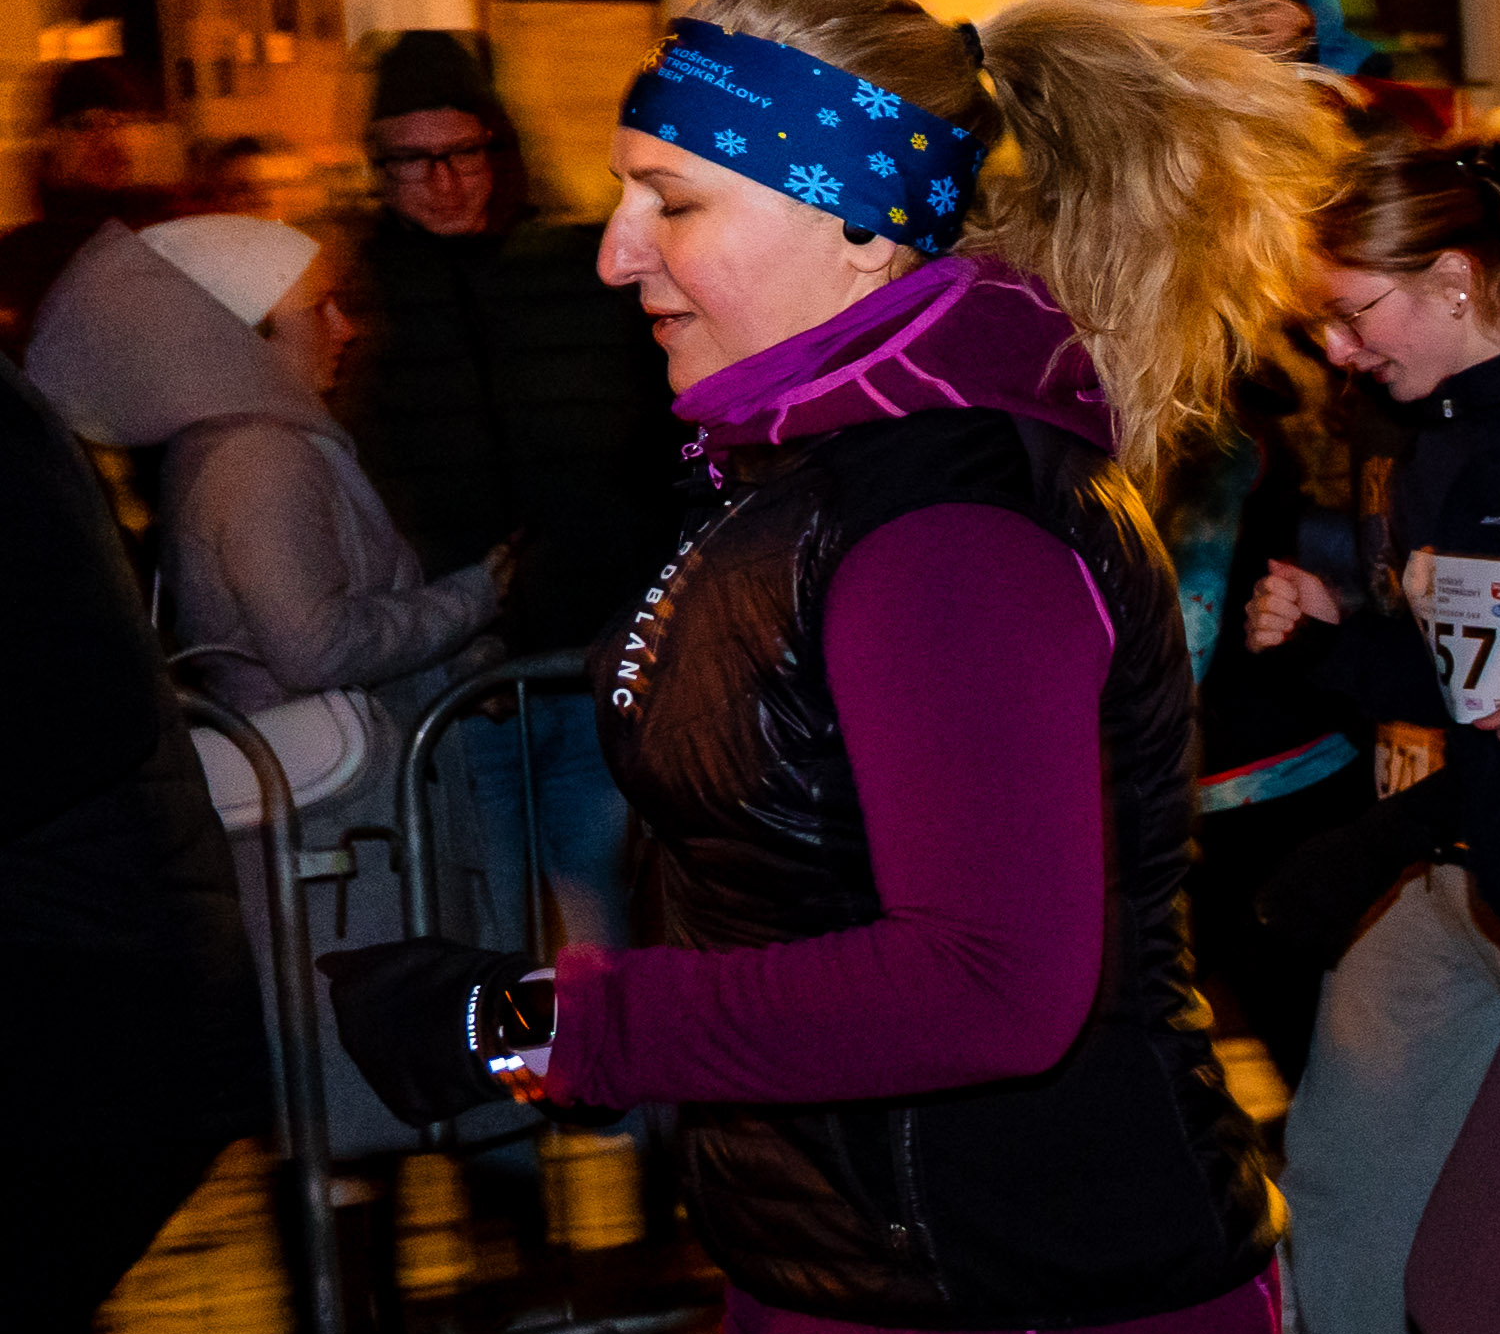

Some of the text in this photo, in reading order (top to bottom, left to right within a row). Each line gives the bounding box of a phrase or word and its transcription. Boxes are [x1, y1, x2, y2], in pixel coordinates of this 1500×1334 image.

[657, 67, 685, 83] BEH
[671, 45, 735, 77] KOŠICKÝ
[665, 55, 773, 109] TROJKRÁĽOVÝ
